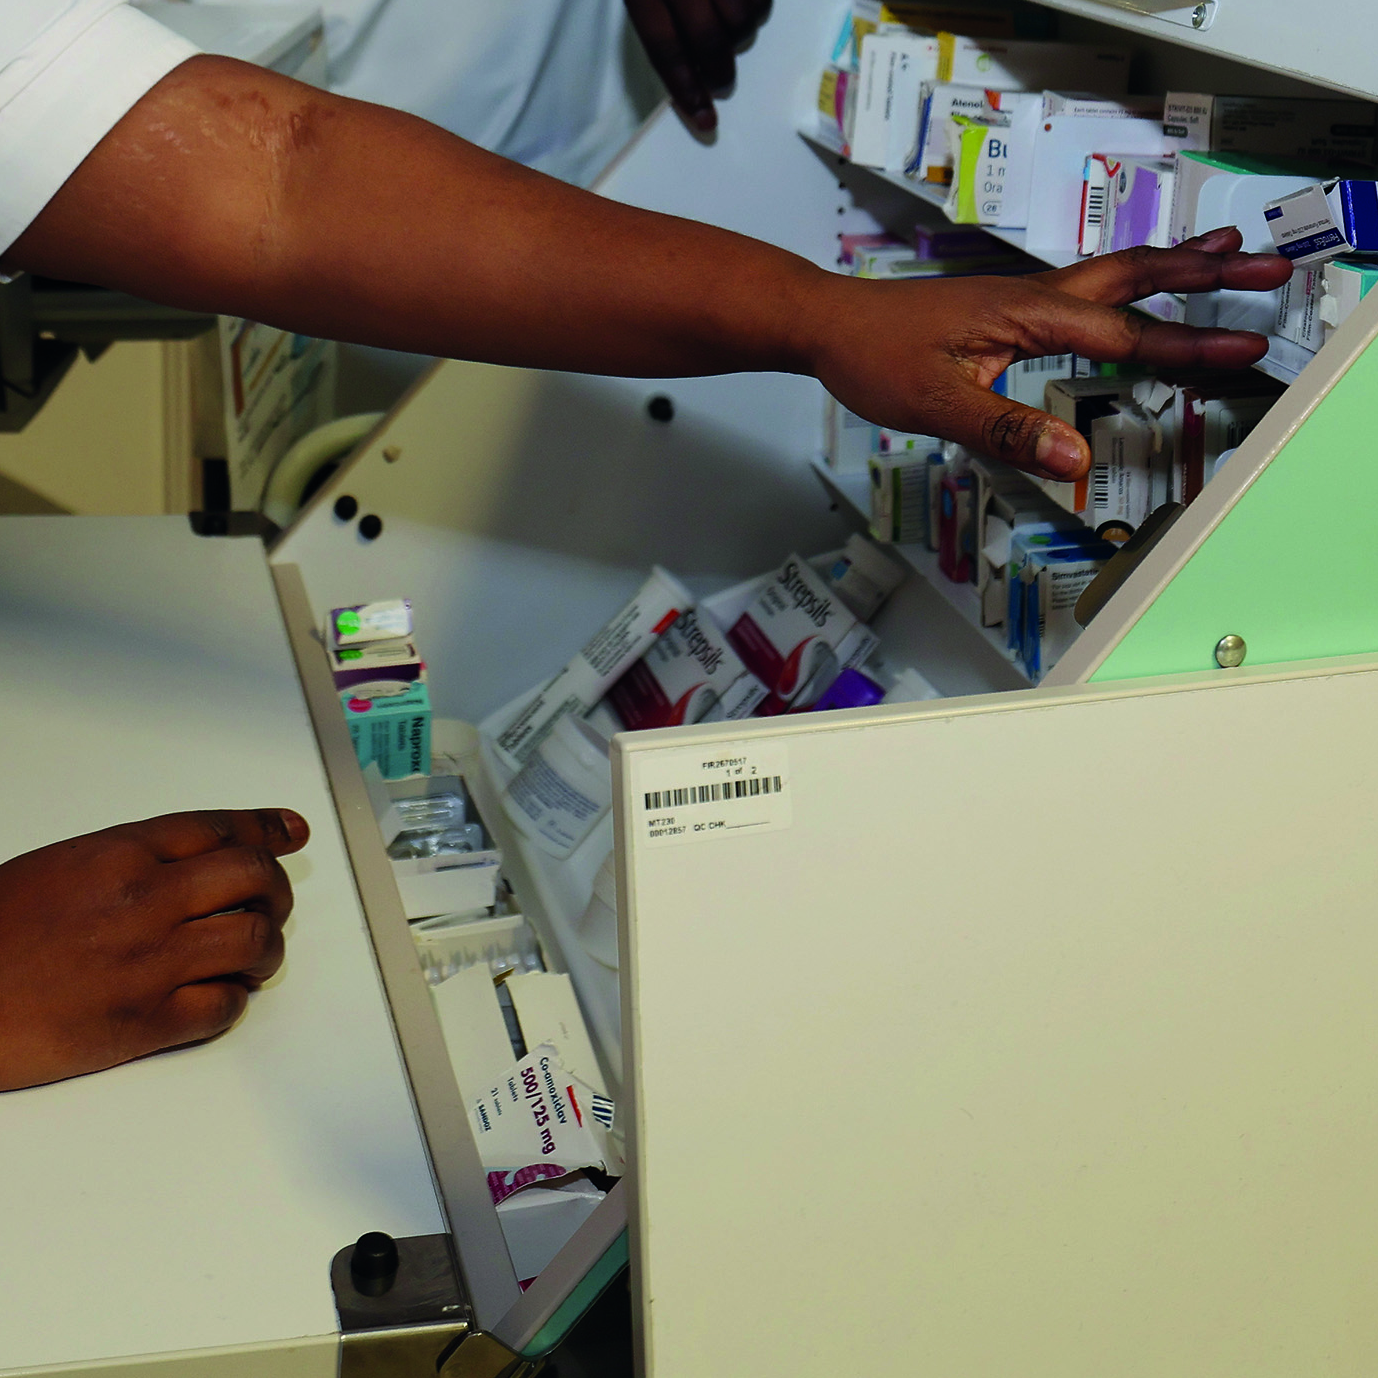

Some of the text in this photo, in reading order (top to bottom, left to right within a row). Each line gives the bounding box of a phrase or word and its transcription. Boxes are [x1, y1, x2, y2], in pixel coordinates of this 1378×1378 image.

[777, 562, 836, 627] Strepsils
[676, 606, 724, 676] Strepsils
[726, 766, 758, 777] 1 of 2
[694, 822, 707, 832] QC
[491, 1087, 500, 1098] 21
[507, 1076, 519, 1103] Tablets
[539, 1057, 568, 1125] Co-amoxiclav
[478, 1104, 492, 1132] SANDOZ
[520, 1066, 557, 1155] 500/125 mg
